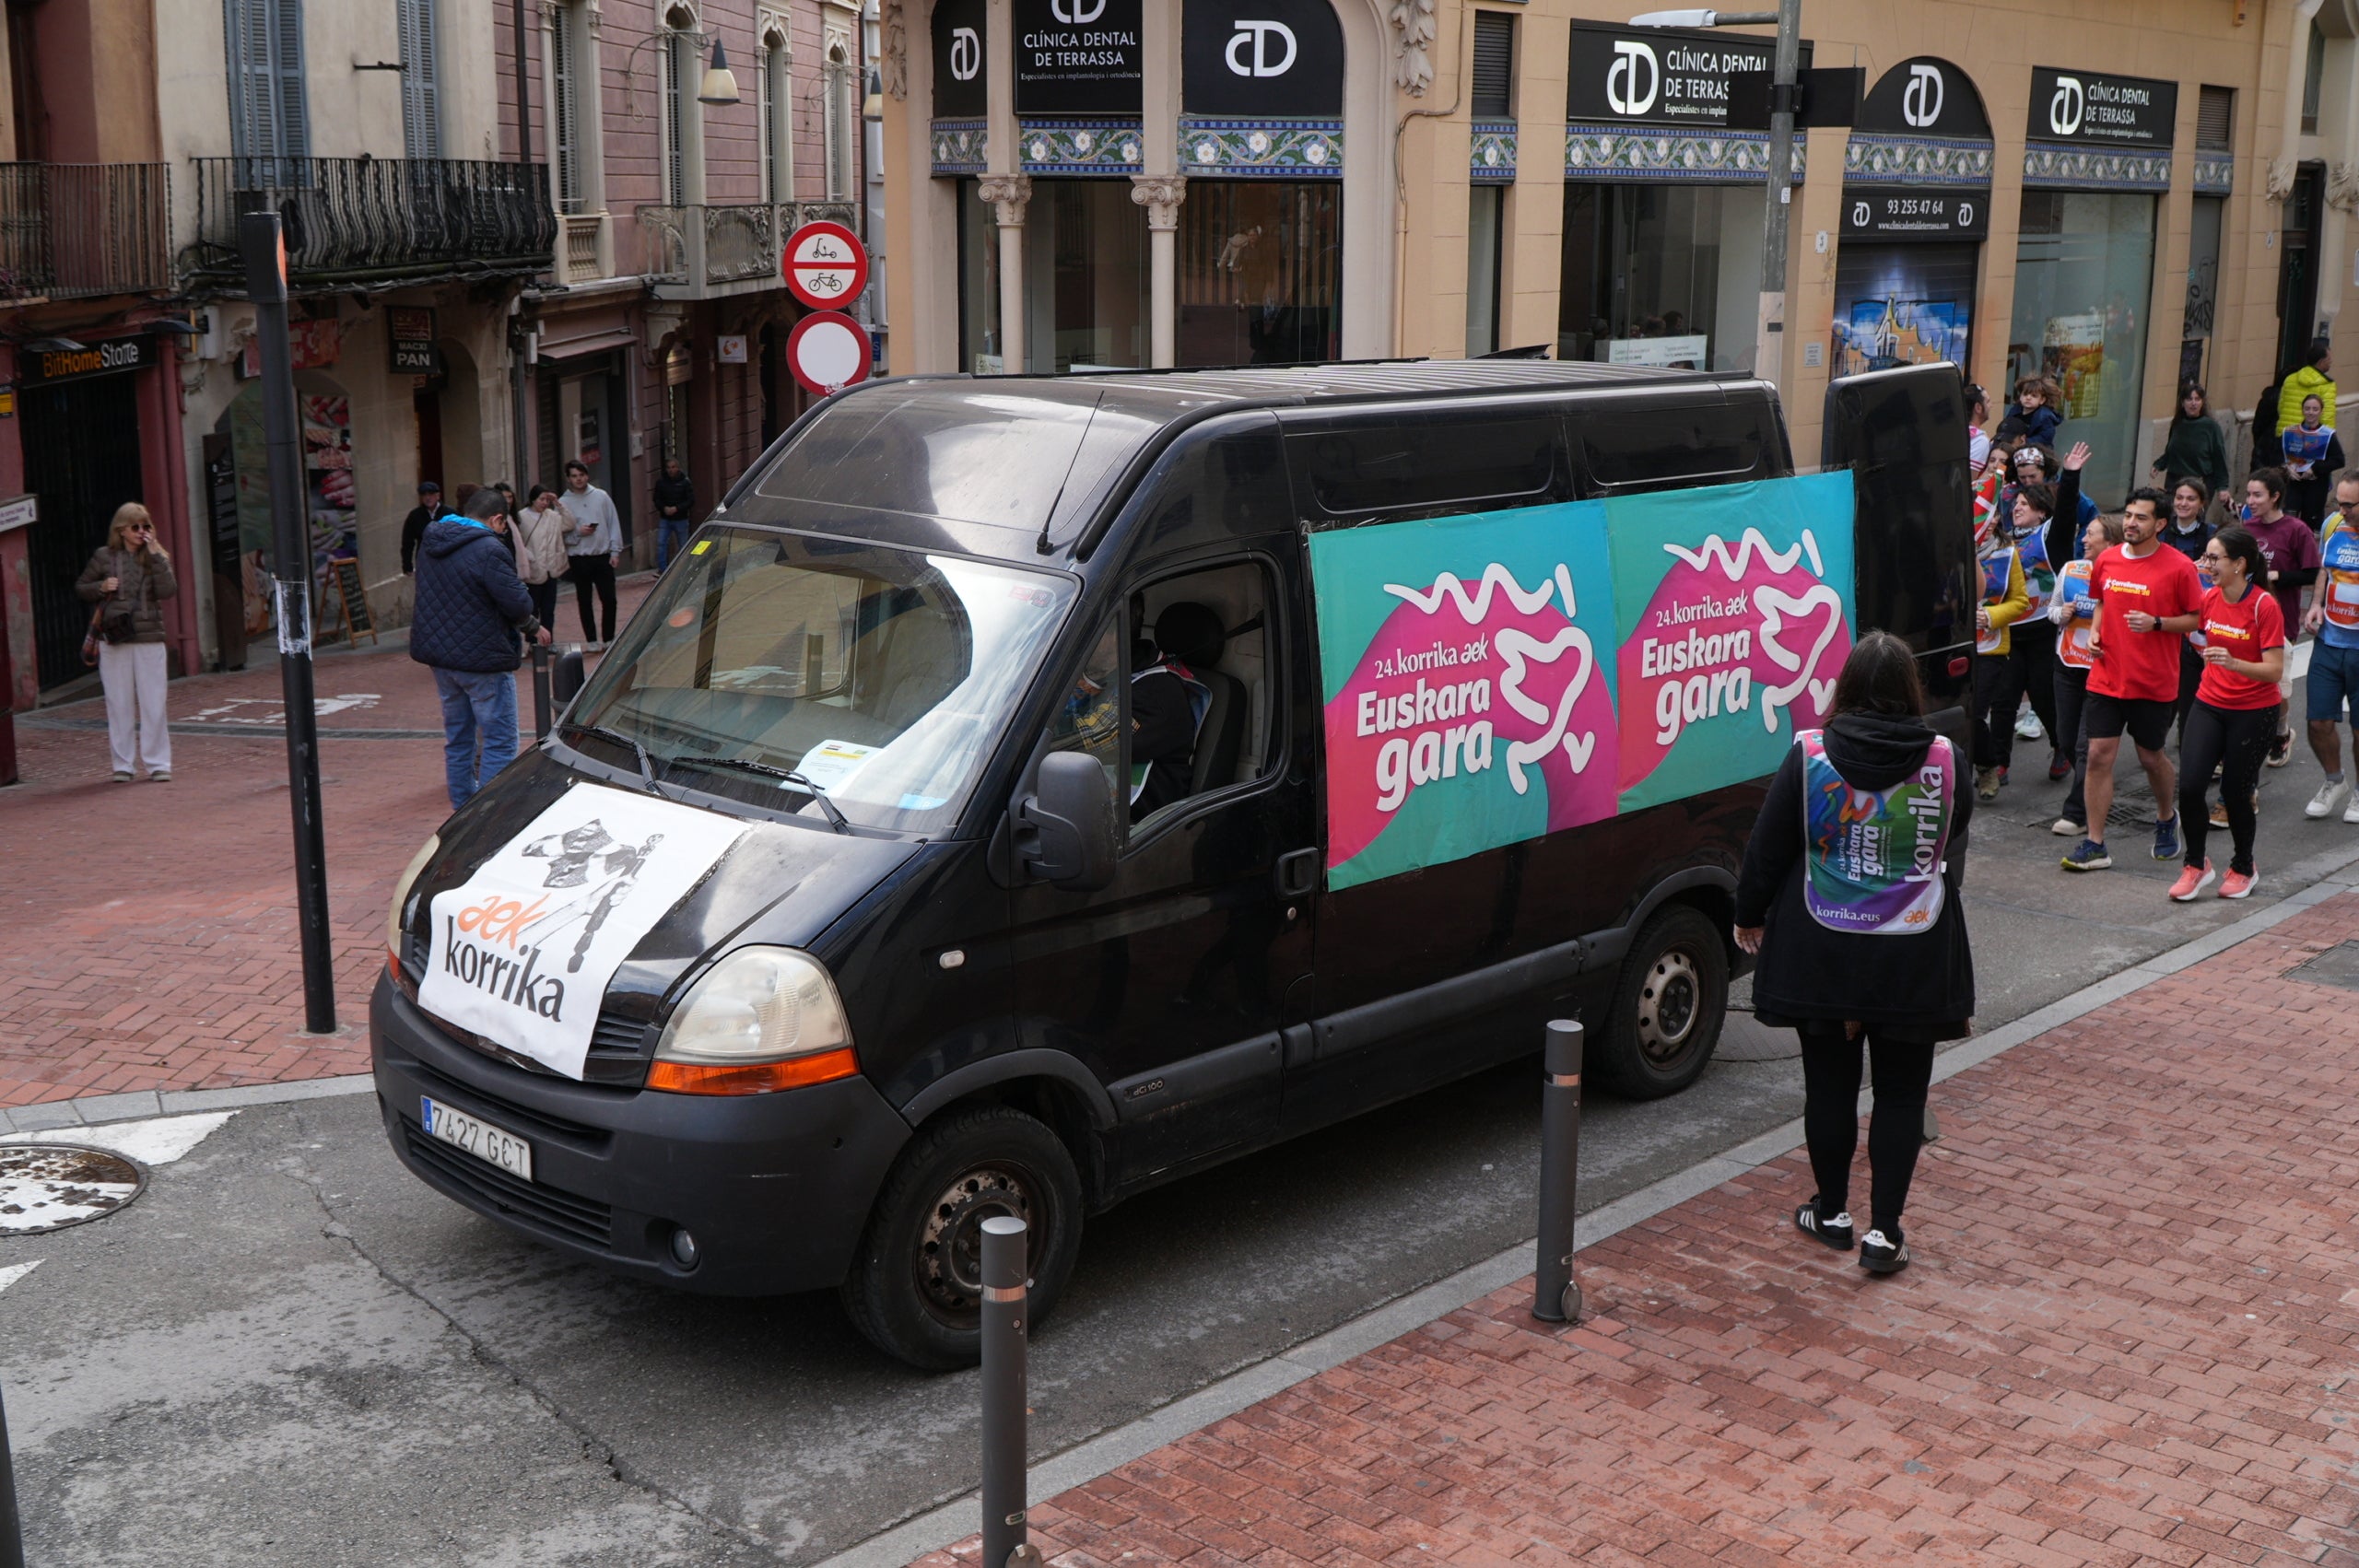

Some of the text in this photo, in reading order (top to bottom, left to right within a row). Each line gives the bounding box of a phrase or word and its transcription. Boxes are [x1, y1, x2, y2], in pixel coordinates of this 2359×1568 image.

[1024, 29, 1136, 48] CLÍNICA DENTAL
[1035, 51, 1124, 66] DE TERRASSA
[1666, 45, 1719, 73] CLÍNICA
[1665, 77, 1729, 100] DE TERRAS
[2088, 80, 2150, 106] CLÍNICA DENTAL
[1664, 102, 1700, 116] Especialistes
[1700, 106, 1708, 114] en
[2085, 105, 2136, 125] DE TERRASSA
[1887, 199, 1943, 214] 93 255 47 64
[396, 353, 431, 367] PAN
[1656, 595, 1724, 627] 24.korrika
[1374, 635, 1459, 679] 24.korrika
[1642, 628, 1751, 677] Euskara
[1357, 678, 1491, 737] Euskara
[1656, 668, 1752, 745] gara
[1376, 720, 1494, 813] gara
[1904, 765, 1943, 883] korrika
[1847, 825, 1861, 882] Euskara
[1861, 825, 1884, 876] gara
[457, 895, 549, 950] aek
[1816, 905, 1881, 922] korrika.eus
[444, 914, 565, 1023] korrika
[1147, 1080, 1164, 1091] 100
[432, 1106, 479, 1152] 7427
